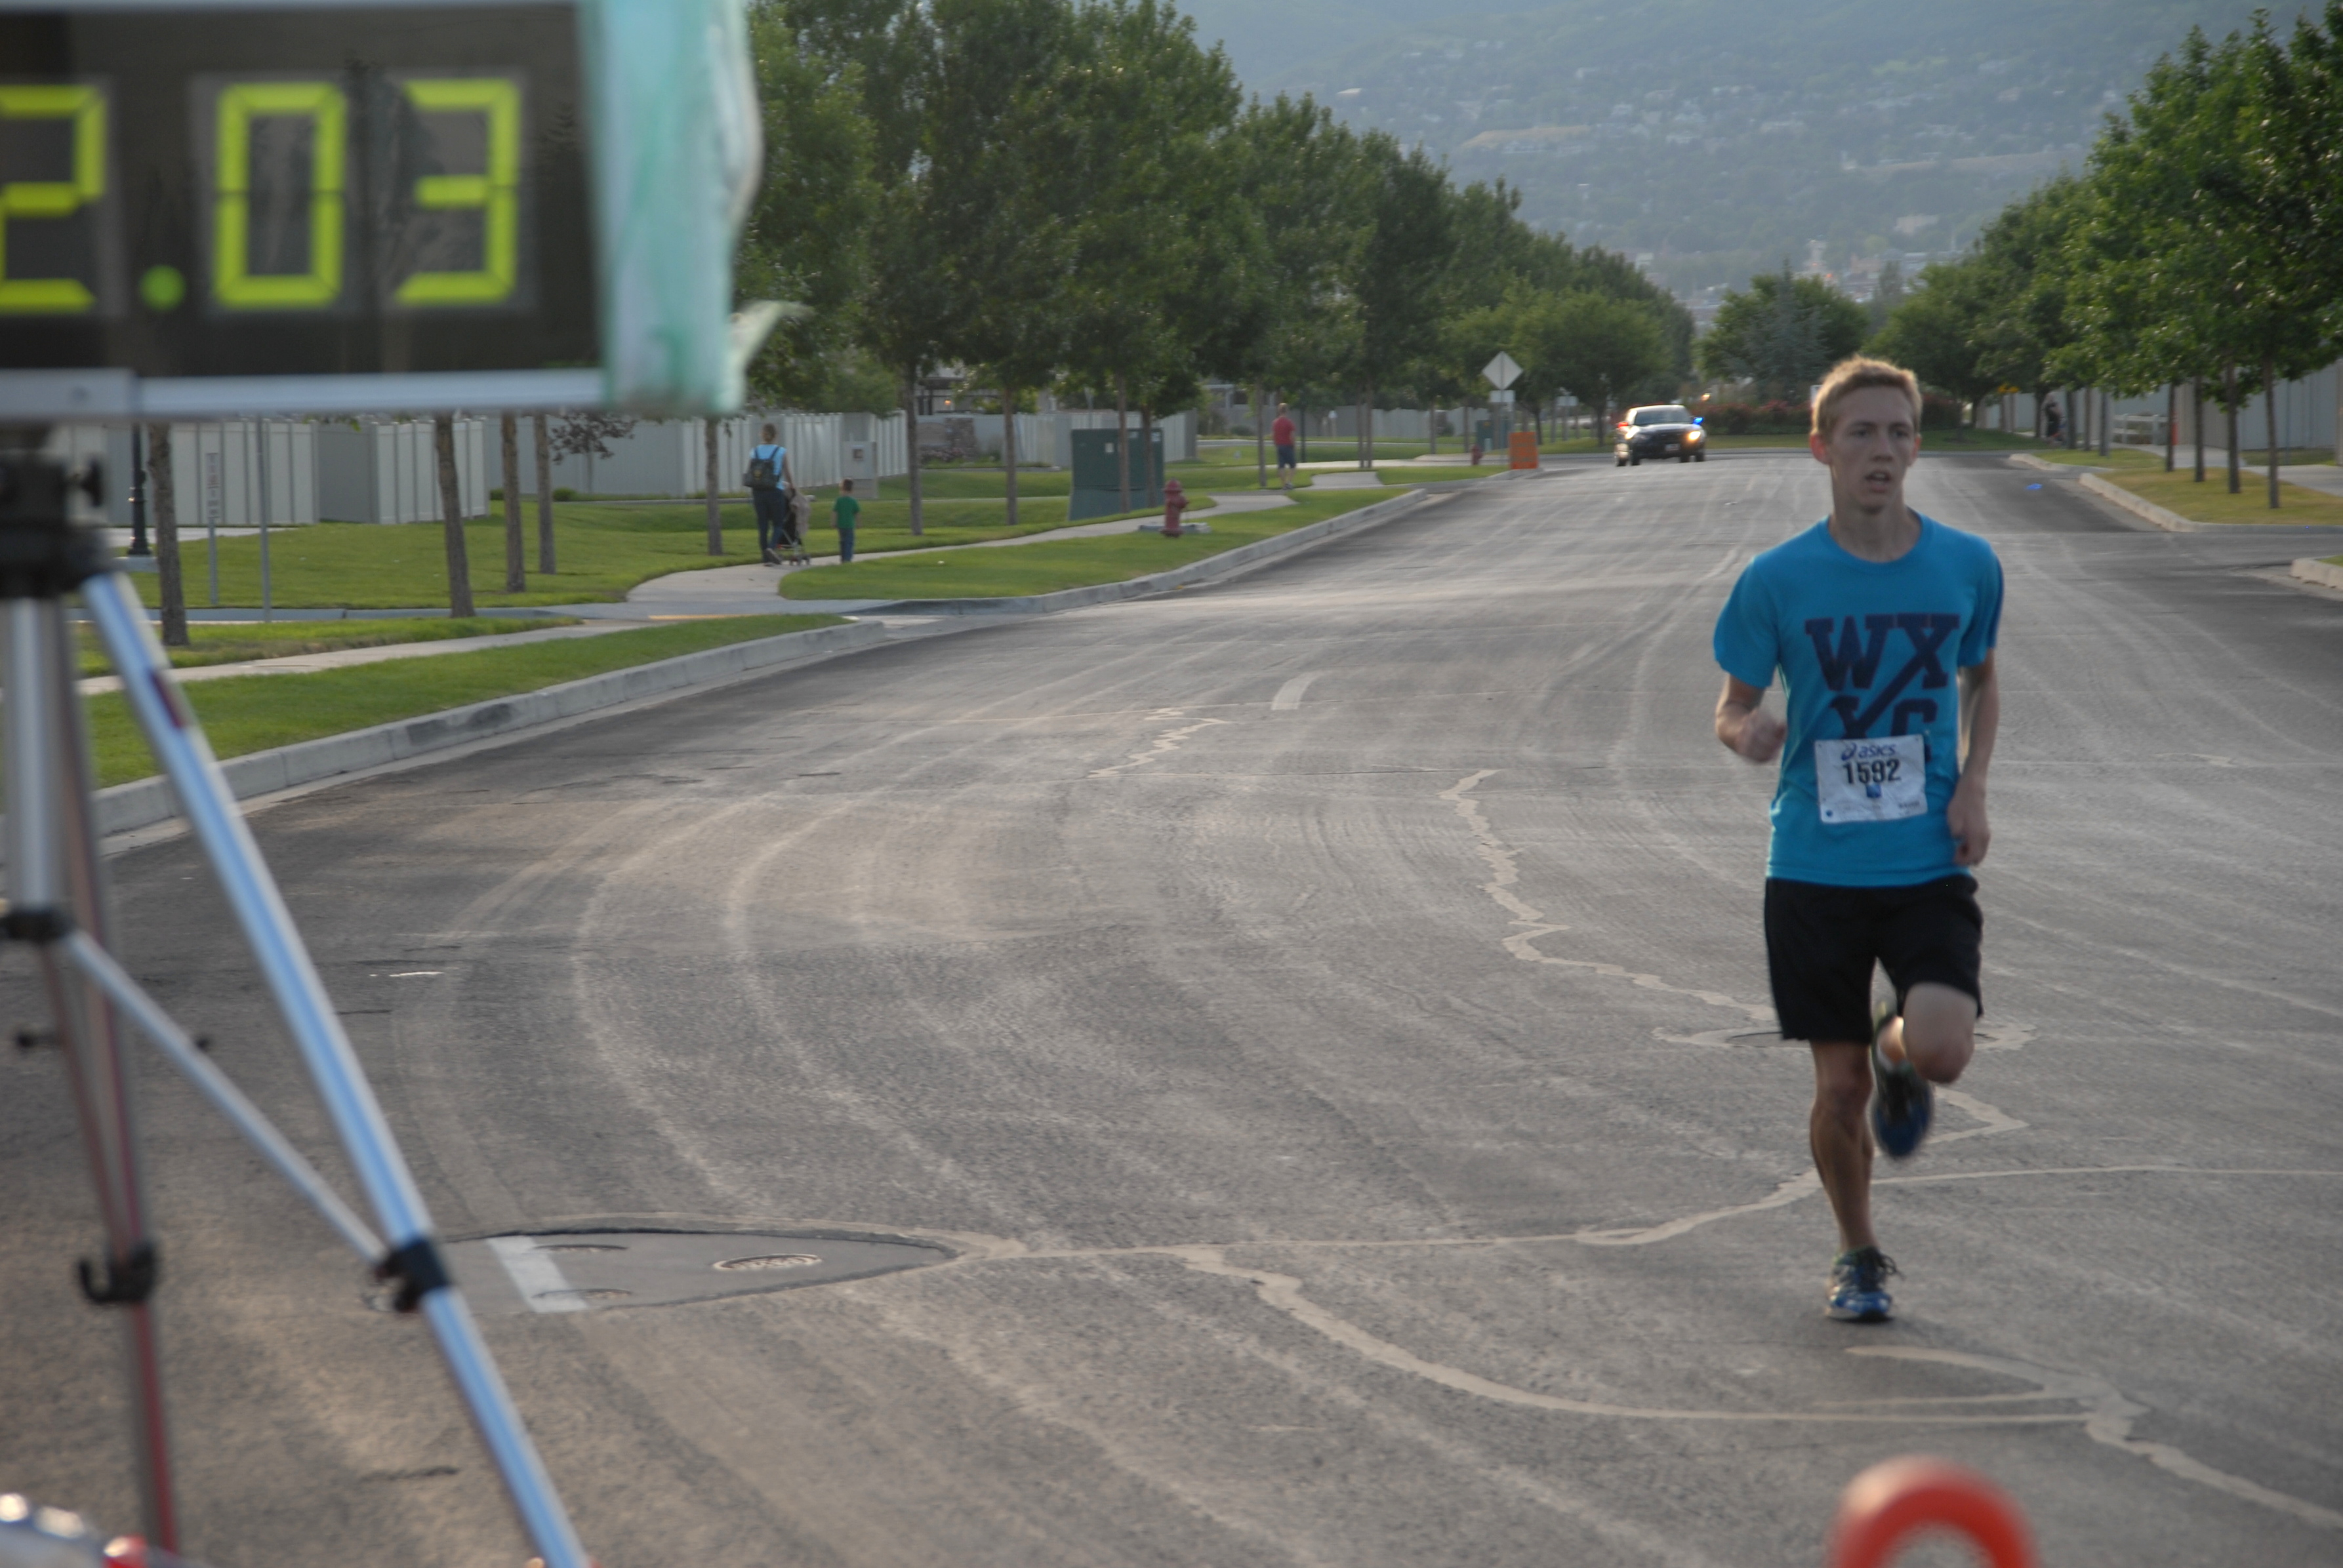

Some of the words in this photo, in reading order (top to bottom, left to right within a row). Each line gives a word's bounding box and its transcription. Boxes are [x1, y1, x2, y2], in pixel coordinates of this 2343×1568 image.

[1804, 613, 1960, 691] WX
[1858, 744, 1896, 758] asics
[1843, 758, 1902, 784] 1592
